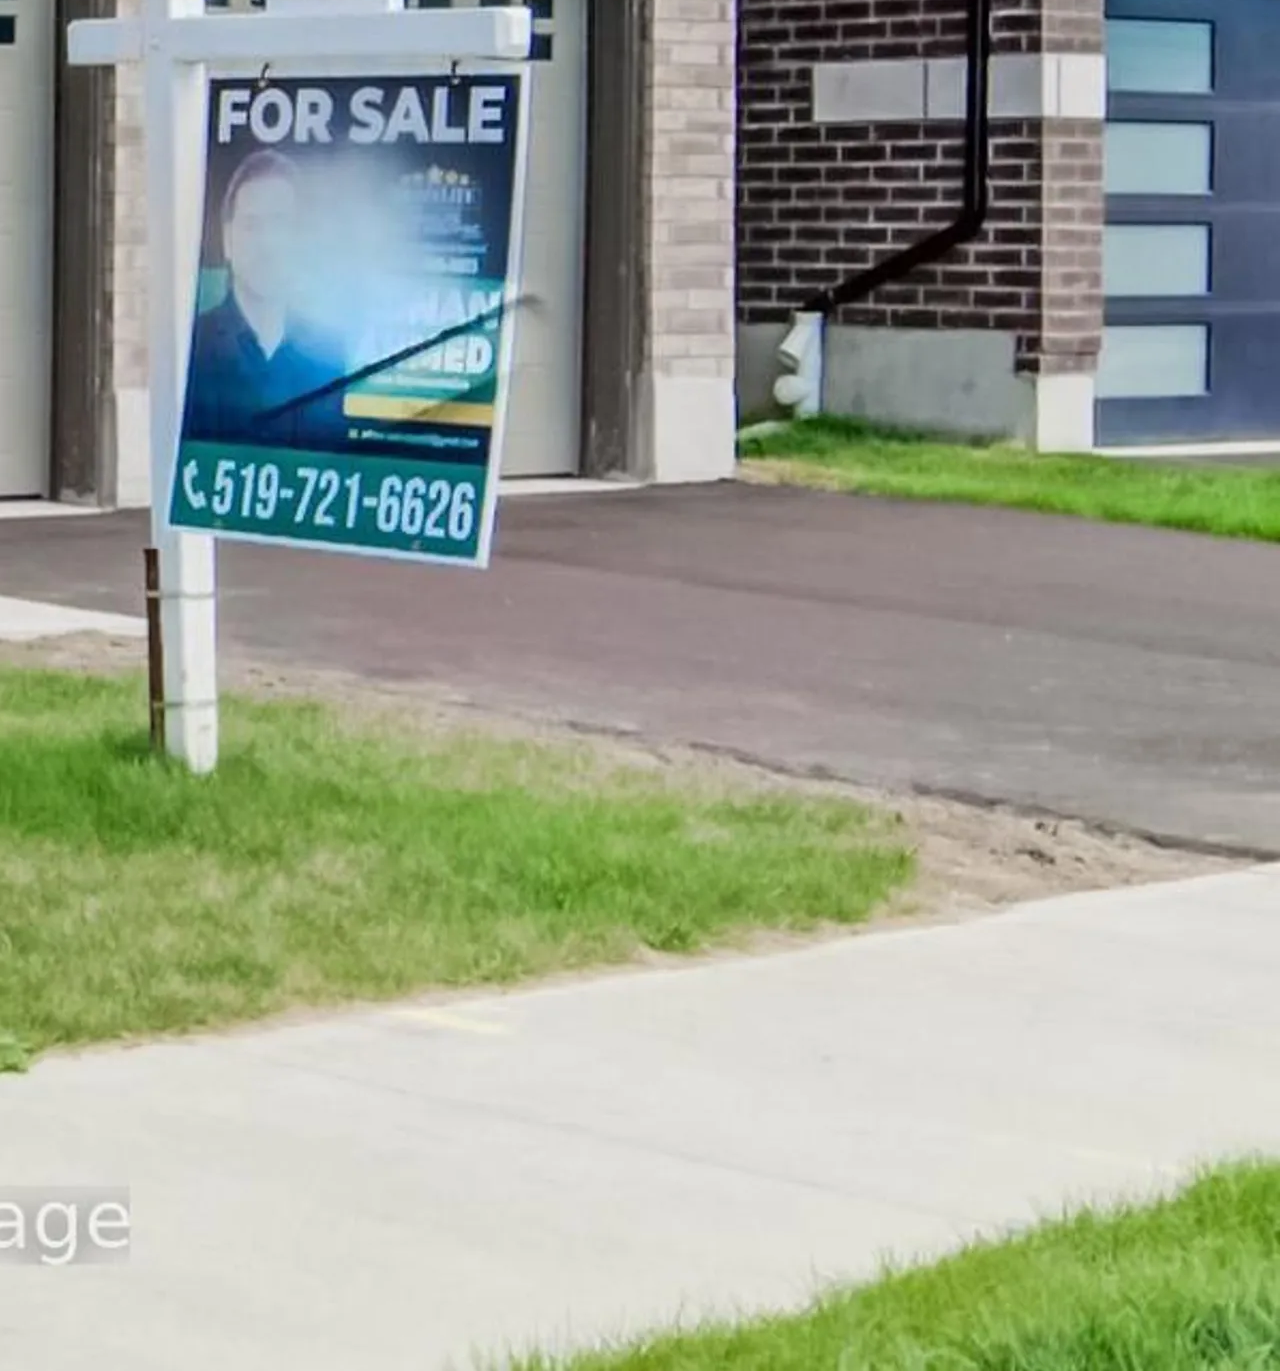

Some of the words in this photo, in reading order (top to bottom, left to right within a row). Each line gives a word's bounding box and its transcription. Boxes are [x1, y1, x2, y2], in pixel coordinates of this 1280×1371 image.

[218, 86, 334, 143] FOR
[348, 85, 507, 144] SALE
[211, 459, 476, 540] 519-721-6626
